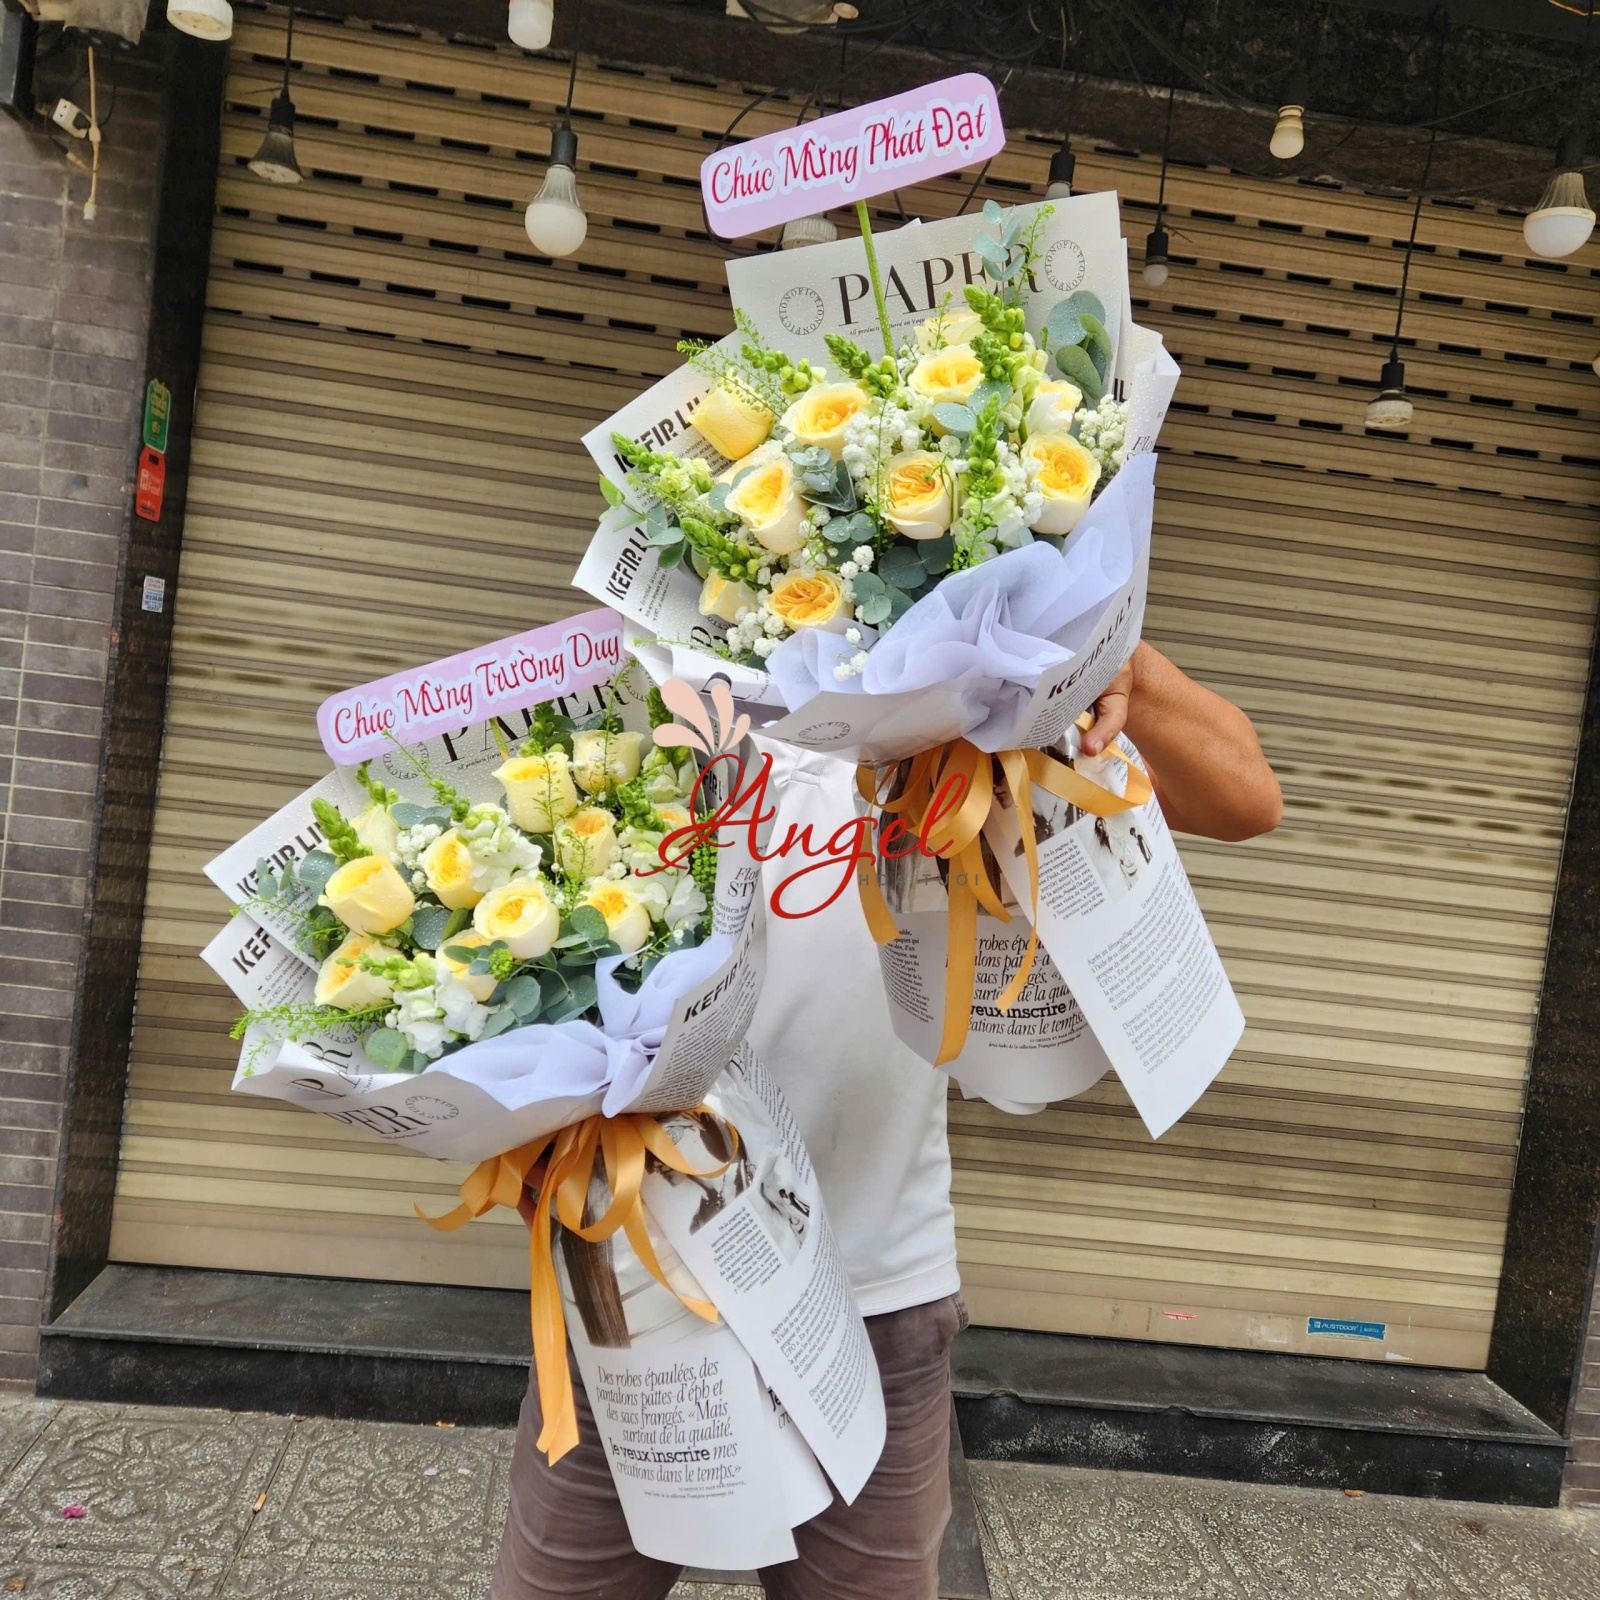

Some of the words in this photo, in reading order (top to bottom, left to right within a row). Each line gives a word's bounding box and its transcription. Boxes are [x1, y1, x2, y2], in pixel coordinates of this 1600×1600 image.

[711, 155, 775, 205] Chúc
[778, 137, 859, 184] Mừng
[863, 117, 926, 166] Phát
[931, 102, 986, 153] Đạt
[912, 317, 925, 325] Vogu
[605, 543, 642, 601] KEFIR
[334, 701, 395, 744] Chúc
[397, 680, 473, 723] Mừng
[475, 650, 565, 697] Trường
[567, 632, 620, 669] Duy
[232, 926, 273, 975] KEF
[978, 934, 1009, 951] robes
[976, 971, 999, 984] sacs
[1017, 985, 1032, 1002] de
[1034, 984, 1045, 1001] la
[1006, 1002, 1067, 1019] inscrire
[1007, 1019, 1036, 1036] dans
[1039, 1015, 1048, 1034] le
[598, 1366, 614, 1385] Des
[616, 1369, 642, 1388] robes
[645, 1363, 697, 1391] épaulées,
[699, 1356, 719, 1379] des
[596, 1385, 638, 1406] pantalons
[713, 1379, 723, 1397] et
[606, 1403, 618, 1421] des
[620, 1411, 639, 1424] sacs
[641, 1405, 685, 1429] frangés.
[688, 1398, 728, 1421] «Mais
[623, 1429, 656, 1444] surtout
[660, 1425, 672, 1445] de
[674, 1425, 686, 1443] la
[689, 1418, 733, 1447] qualité.
[620, 1446, 651, 1463] veux
[651, 1447, 710, 1464] inscrire
[713, 1442, 738, 1460] mes
[616, 1460, 654, 1481] créations
[657, 1465, 682, 1483] dans
[685, 1464, 694, 1482] le
